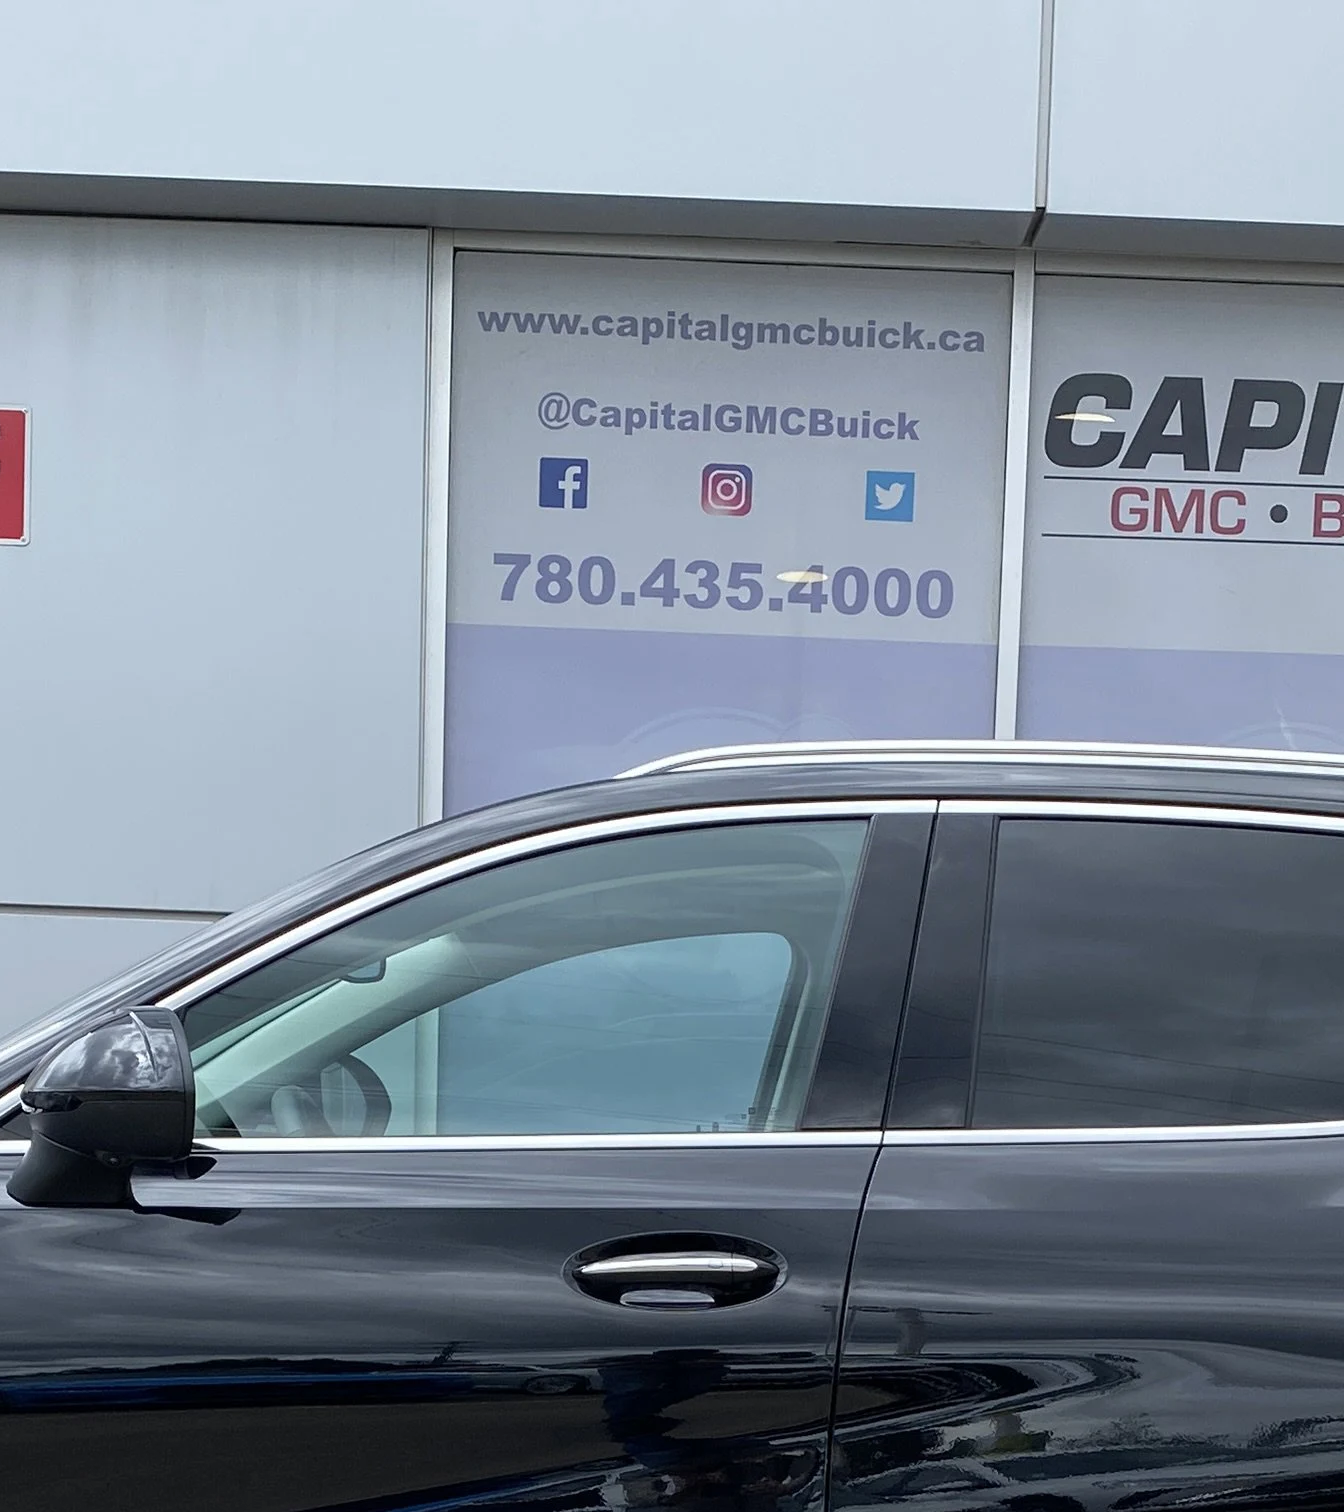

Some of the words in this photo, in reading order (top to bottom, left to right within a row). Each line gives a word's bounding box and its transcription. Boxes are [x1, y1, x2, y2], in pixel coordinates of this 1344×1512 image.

[477, 311, 986, 353] www.capitalgmcbuick.ca
[538, 391, 920, 441] @CapitalGMCBuick
[1110, 487, 1247, 535] GMC
[492, 552, 955, 619] 780.435.4000
